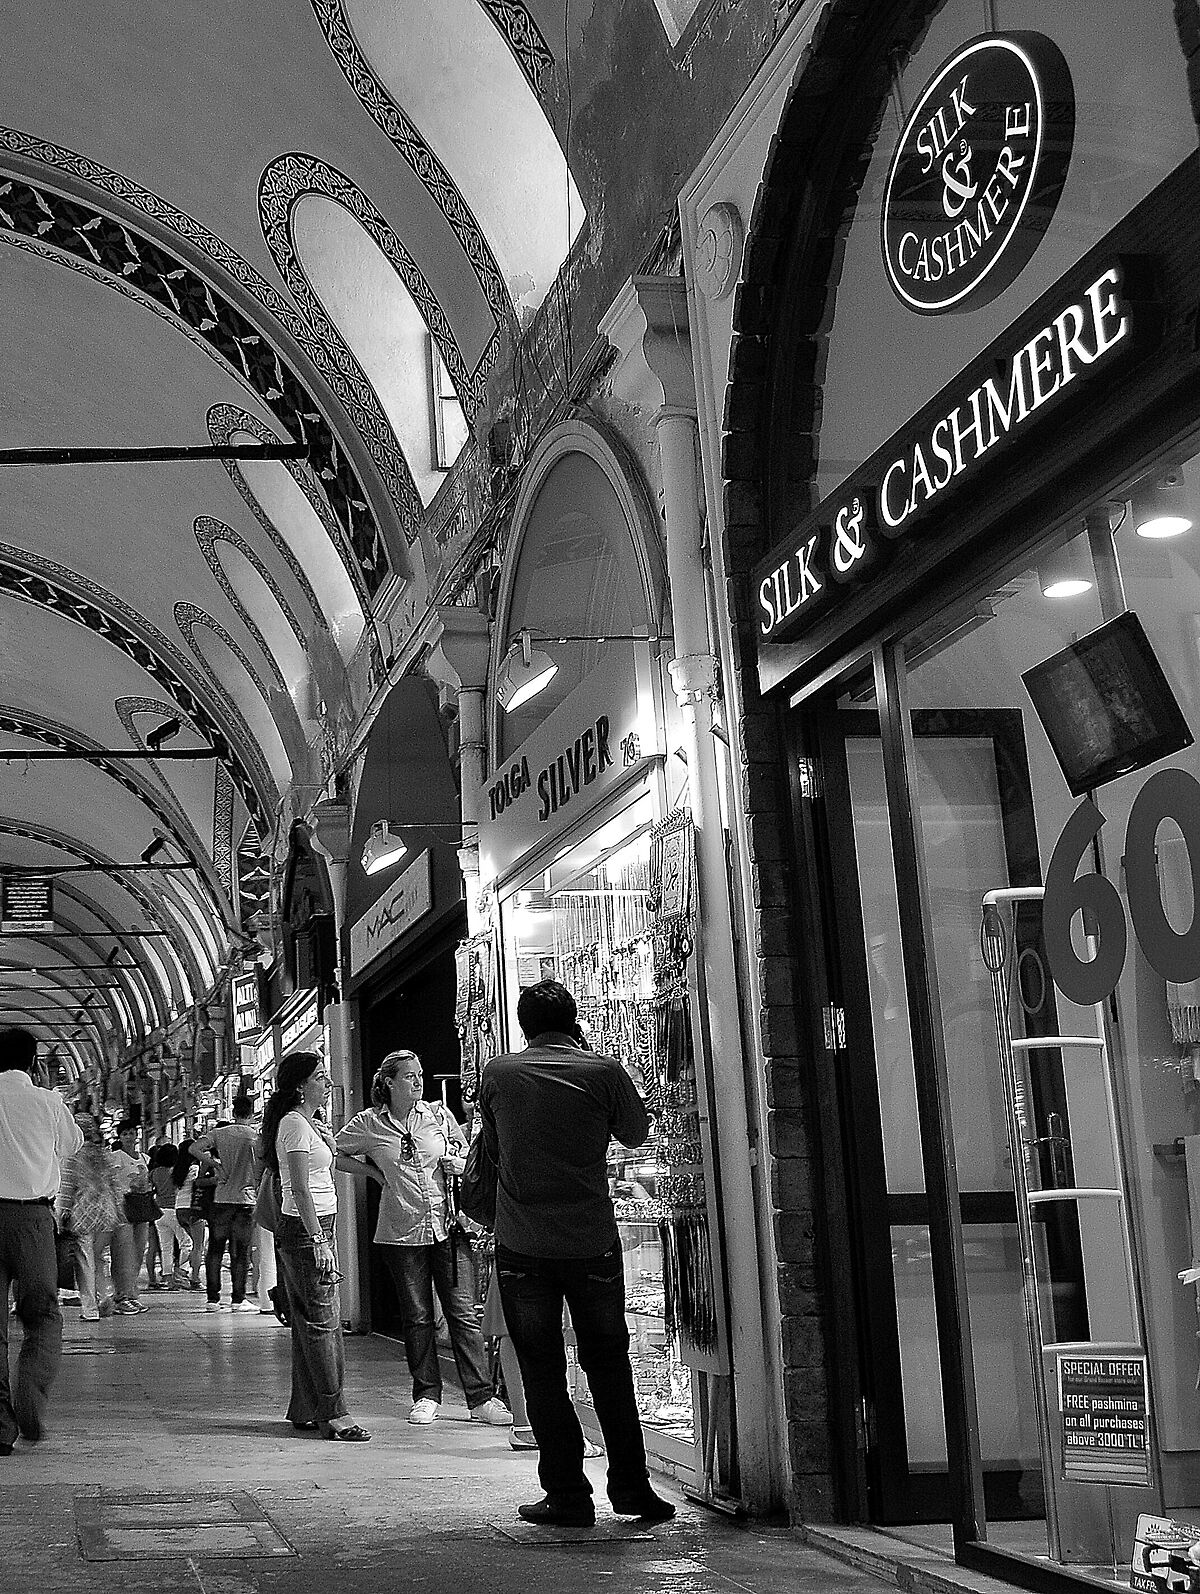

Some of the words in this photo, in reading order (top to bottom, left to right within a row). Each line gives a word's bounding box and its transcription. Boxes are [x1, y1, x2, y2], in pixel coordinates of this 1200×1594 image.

[916, 75, 976, 175] SILK
[897, 99, 1033, 284] CASHMERE
[940, 139, 979, 219] &
[758, 537, 822, 636] SILK
[832, 496, 866, 575] &
[878, 267, 1129, 531] CASHMERE
[488, 755, 532, 822] TOLGA
[537, 714, 615, 823] SILVER
[1063, 1361, 1106, 1375] SPECIAL
[1108, 1362, 1141, 1376] OFFER
[1066, 1394, 1090, 1409] FREE
[1091, 1396, 1138, 1412] pashmina
[1065, 1416, 1077, 1427] on
[1079, 1413, 1091, 1427] all
[1093, 1414, 1144, 1430] purchases
[1067, 1431, 1095, 1446] above
[1097, 1432, 1125, 1447] 3000
